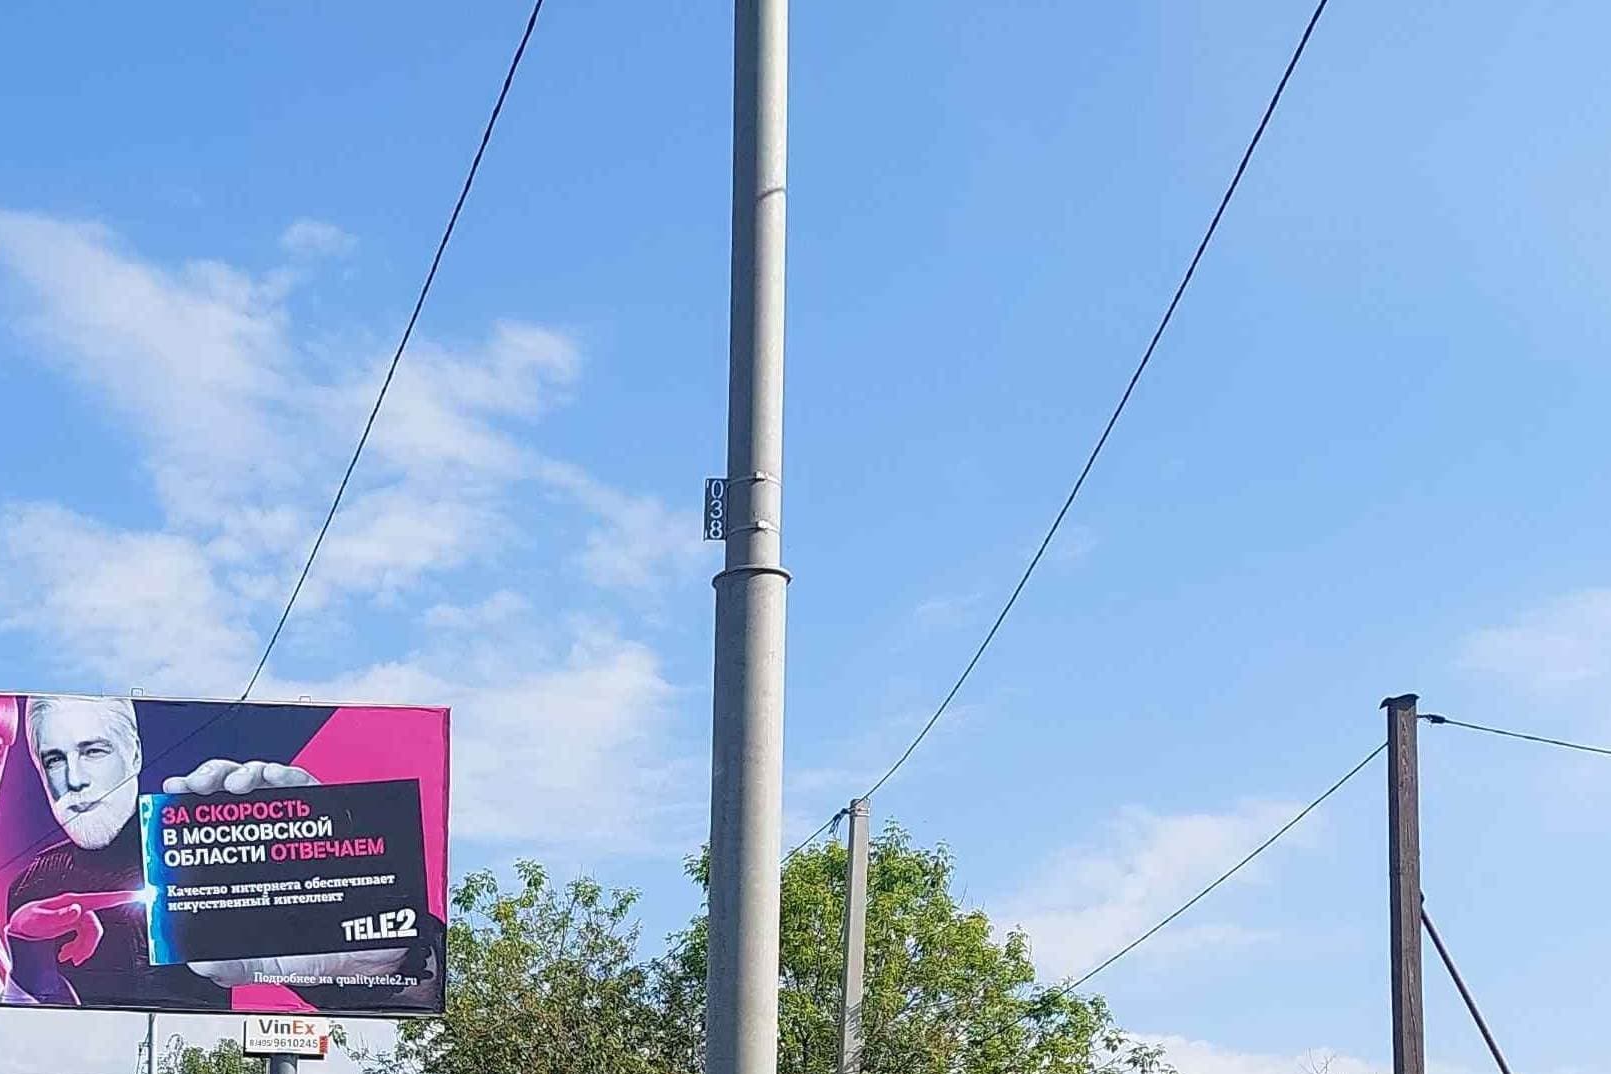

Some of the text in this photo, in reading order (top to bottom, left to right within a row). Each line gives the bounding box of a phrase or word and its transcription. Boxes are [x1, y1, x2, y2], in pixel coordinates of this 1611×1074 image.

[709, 480, 724, 539] 038
[161, 800, 311, 825] ЗА СКОРОСТЬ
[163, 816, 333, 845] В МОСКОВСКОЙ
[164, 837, 385, 867] ОБЛАСТИ ОТВЕЧАЕМ
[167, 875, 396, 898] Качество интернета обеспечивает
[167, 892, 344, 913] искусственный интеллект
[341, 908, 418, 941] TELE2
[254, 972, 418, 988] Подробнее на quality.tele2.ru
[258, 1019, 315, 1035] VinEx
